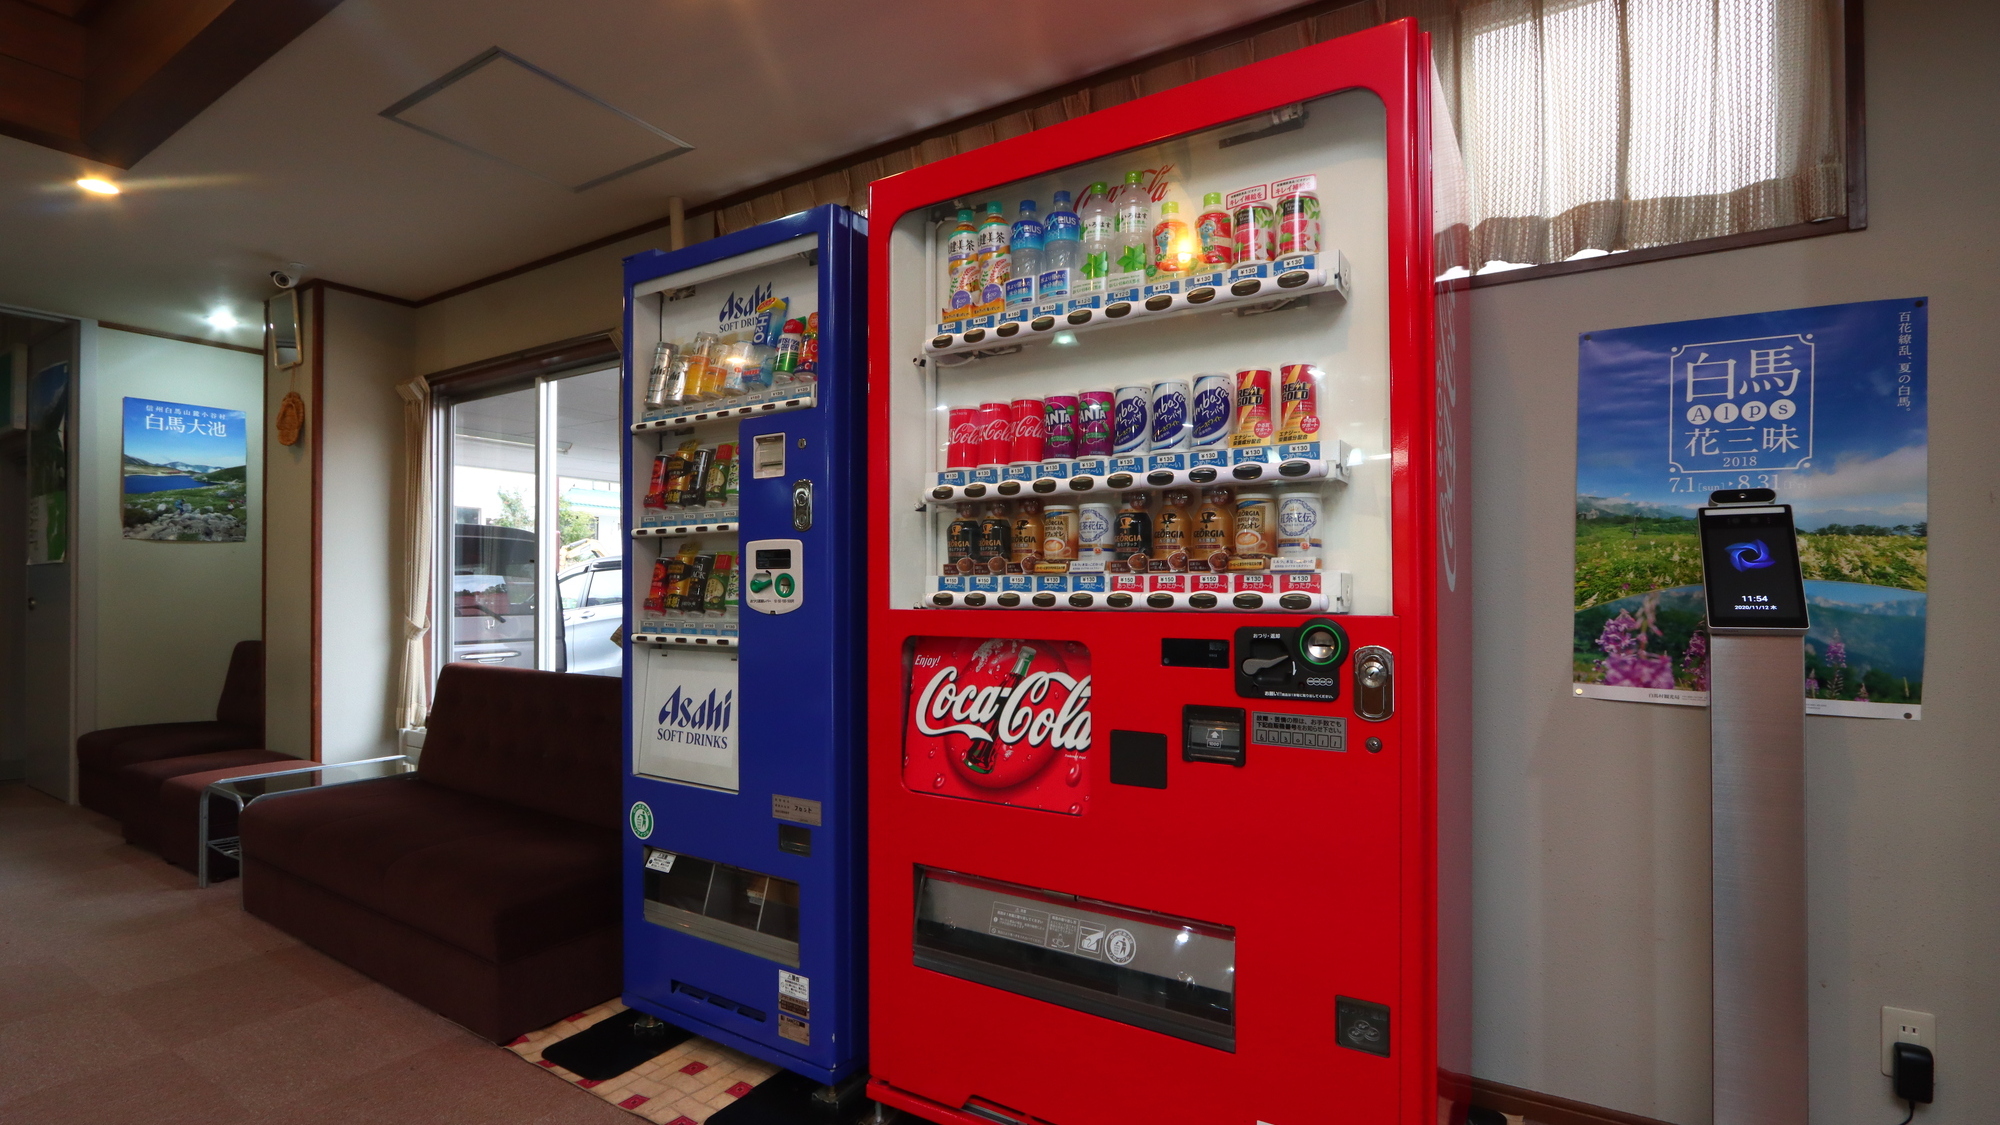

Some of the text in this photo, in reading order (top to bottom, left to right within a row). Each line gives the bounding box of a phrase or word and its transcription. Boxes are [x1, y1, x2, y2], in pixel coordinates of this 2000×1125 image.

[1230, 192, 1263, 206] キレイ補給を
[1121, 212, 1148, 220] いろはす
[719, 281, 772, 323] Asahi
[719, 320, 739, 334] SOFT
[1685, 345, 1801, 403] 白馬
[1238, 384, 1261, 398] REAL
[1282, 378, 1309, 392] REAL
[1237, 395, 1263, 408] GOLD
[1282, 391, 1310, 404] GOLD
[1044, 410, 1072, 426] ANTA
[1080, 406, 1106, 424] ANTA
[1115, 396, 1146, 425] mbasa
[1120, 410, 1142, 427] アンバサ
[1160, 408, 1183, 423] アンバサ
[1202, 402, 1225, 419] アンバサ
[1689, 402, 1791, 422] Alps
[145, 413, 227, 437] 白馬大池
[1232, 438, 1262, 446] 栄養成分配合
[1278, 434, 1308, 442] 栄養成分配合
[1684, 423, 1800, 457] 花三昧
[1722, 456, 1758, 468] 2018
[1669, 477, 1695, 493] 7.1
[1738, 474, 1780, 490] 831
[914, 654, 941, 668] Enjoy!
[658, 684, 732, 733] Asahi
[915, 666, 1091, 750] Coca-Cola
[656, 728, 728, 750] SOFT DRINKS
